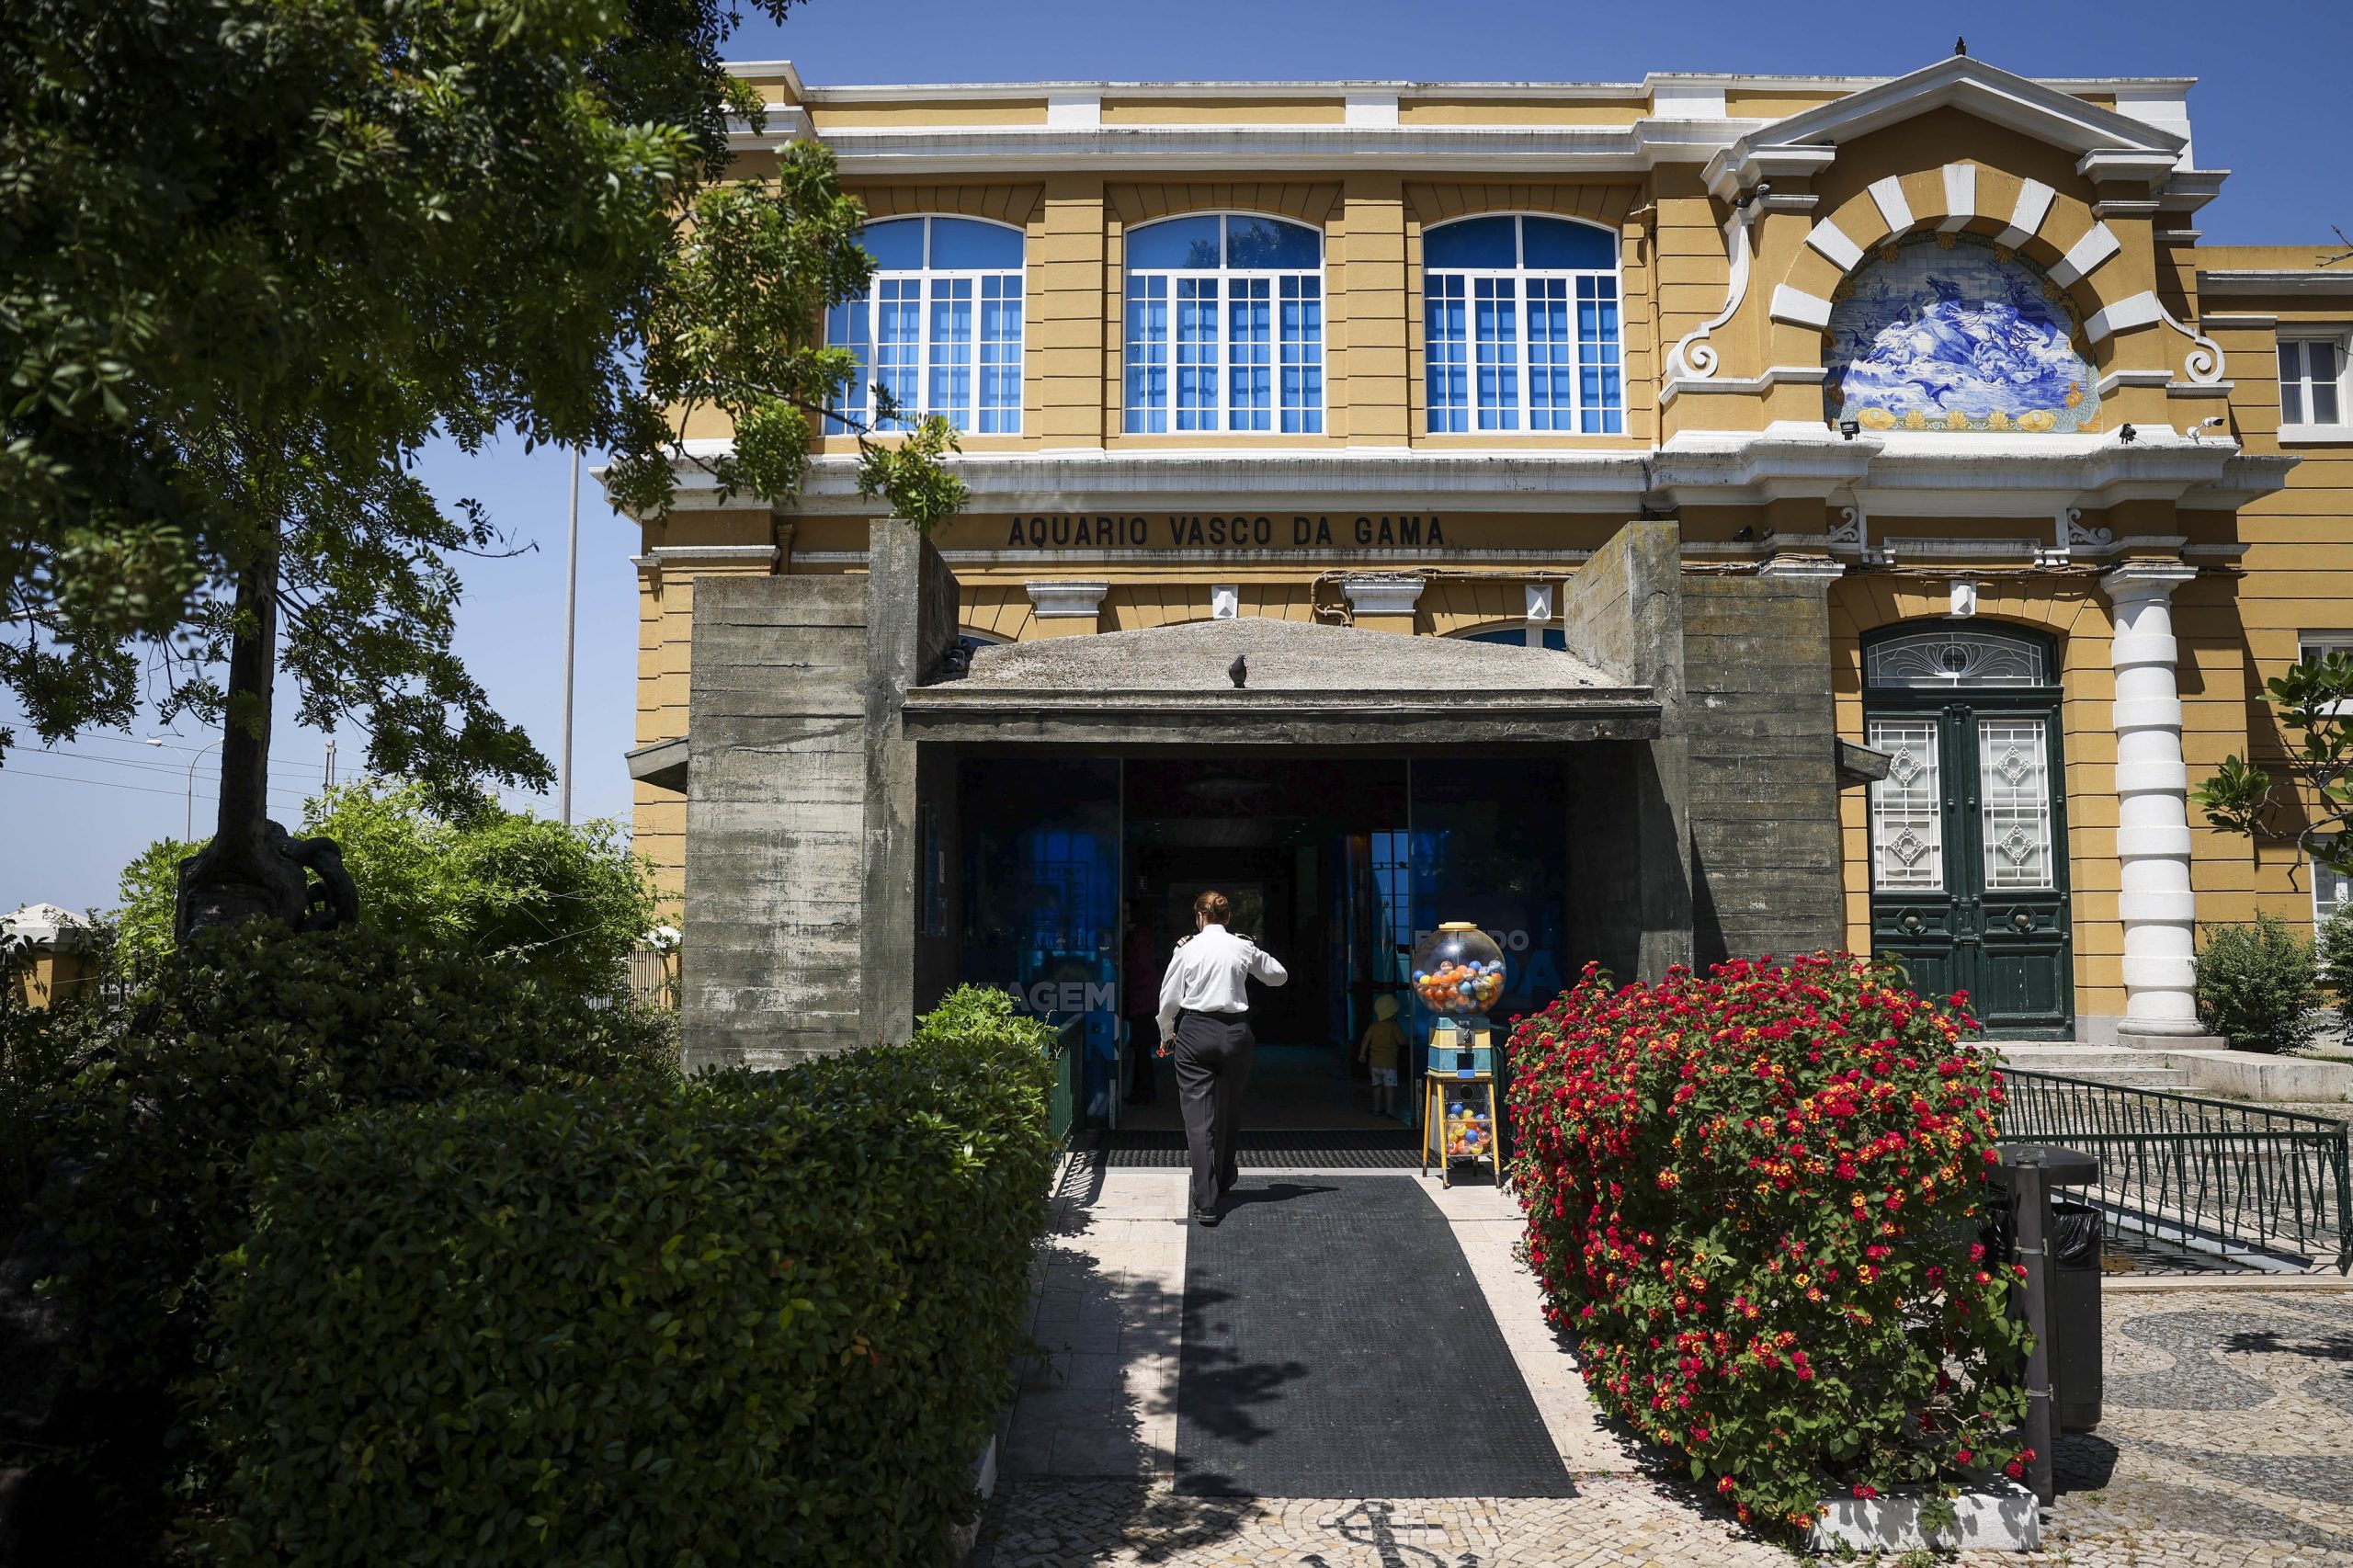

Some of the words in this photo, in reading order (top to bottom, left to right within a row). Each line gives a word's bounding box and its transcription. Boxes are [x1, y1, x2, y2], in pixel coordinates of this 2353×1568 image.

[1007, 516, 1148, 548] AQUARIO
[1169, 516, 1272, 547] VASCO
[1293, 516, 1333, 547] DA
[1354, 516, 1445, 547] GAMA
[978, 982, 1115, 1012] AGEM
